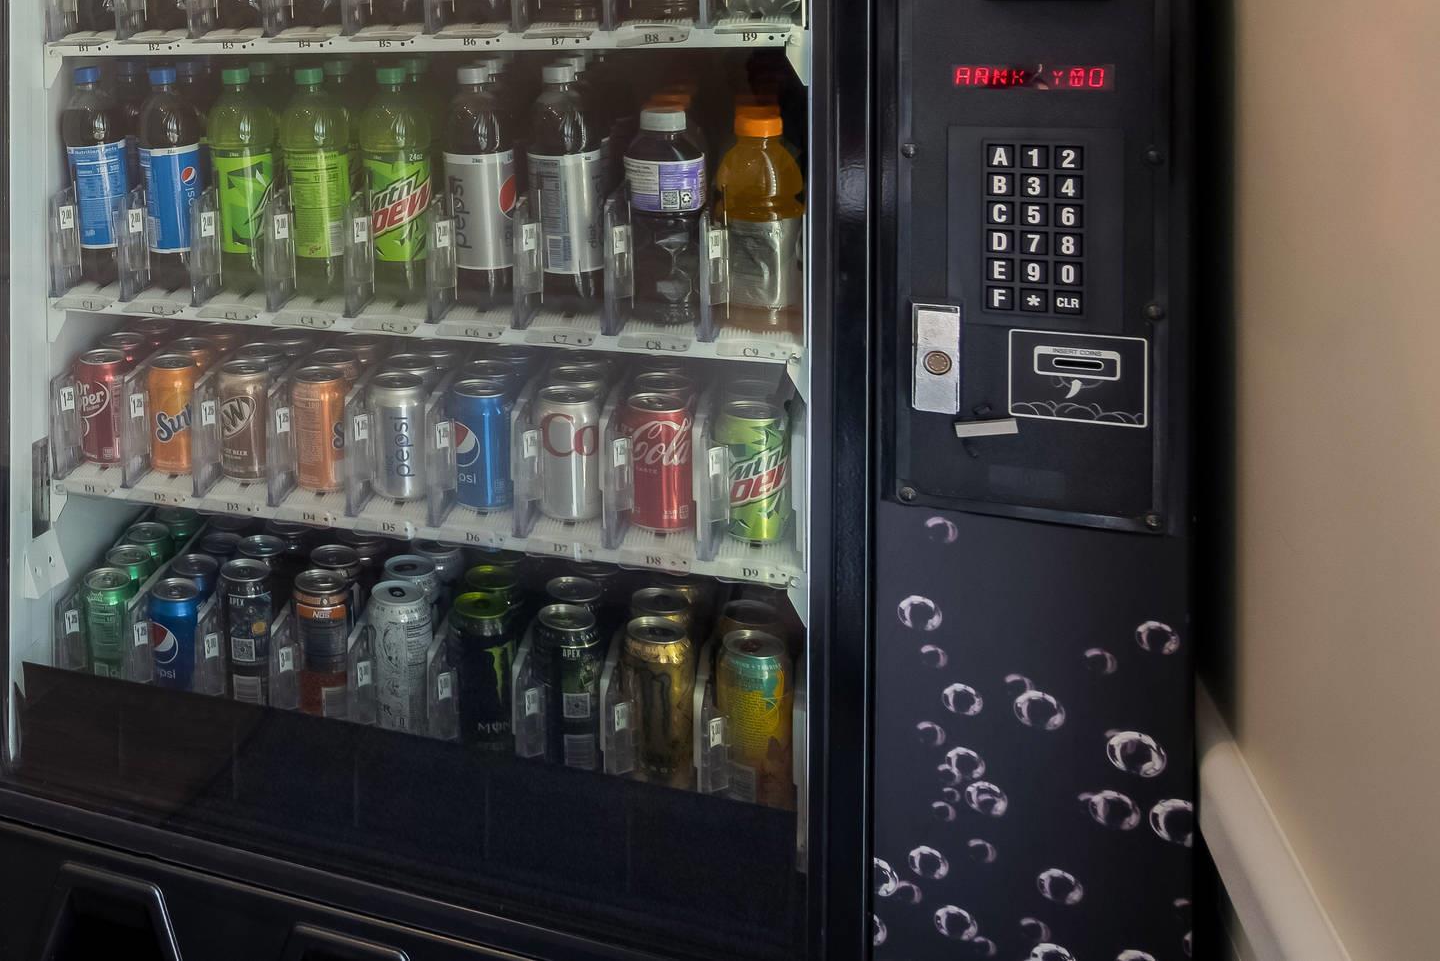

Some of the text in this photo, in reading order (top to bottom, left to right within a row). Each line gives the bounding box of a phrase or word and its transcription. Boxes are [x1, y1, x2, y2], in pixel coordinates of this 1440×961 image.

[463, 37, 477, 47] B6
[551, 36, 565, 47] B7
[644, 32, 660, 43] B8
[741, 32, 758, 42] B9
[78, 43, 90, 52] B1
[148, 42, 161, 51] B2
[222, 41, 234, 50] B3
[298, 40, 312, 49] B4
[378, 38, 392, 48] B5
[992, 147, 1075, 169] A 1 2
[992, 175, 1076, 197] B 3 4
[992, 203, 1075, 227] C 5 6
[992, 232, 1075, 255] D 7 8
[992, 260, 1075, 284] E 9 0
[992, 289, 1080, 309] F CLR
[82, 301, 94, 310] C1
[151, 305, 164, 315] C2
[224, 311, 238, 321] C3
[300, 316, 314, 325] C4
[381, 321, 395, 332] C5
[465, 327, 479, 338] C6
[553, 334, 568, 345] C7
[646, 340, 661, 351] C8
[742, 347, 759, 358] C9
[393, 416, 416, 478] pepsi
[84, 484, 95, 493] D1
[153, 493, 167, 502] D2
[226, 503, 239, 512] D3
[302, 511, 316, 521] D4
[382, 522, 396, 532] D5
[465, 532, 480, 542] D6
[553, 543, 568, 553] D7
[646, 555, 661, 565] D8
[742, 567, 759, 578] D9
[562, 648, 581, 659] APEX
